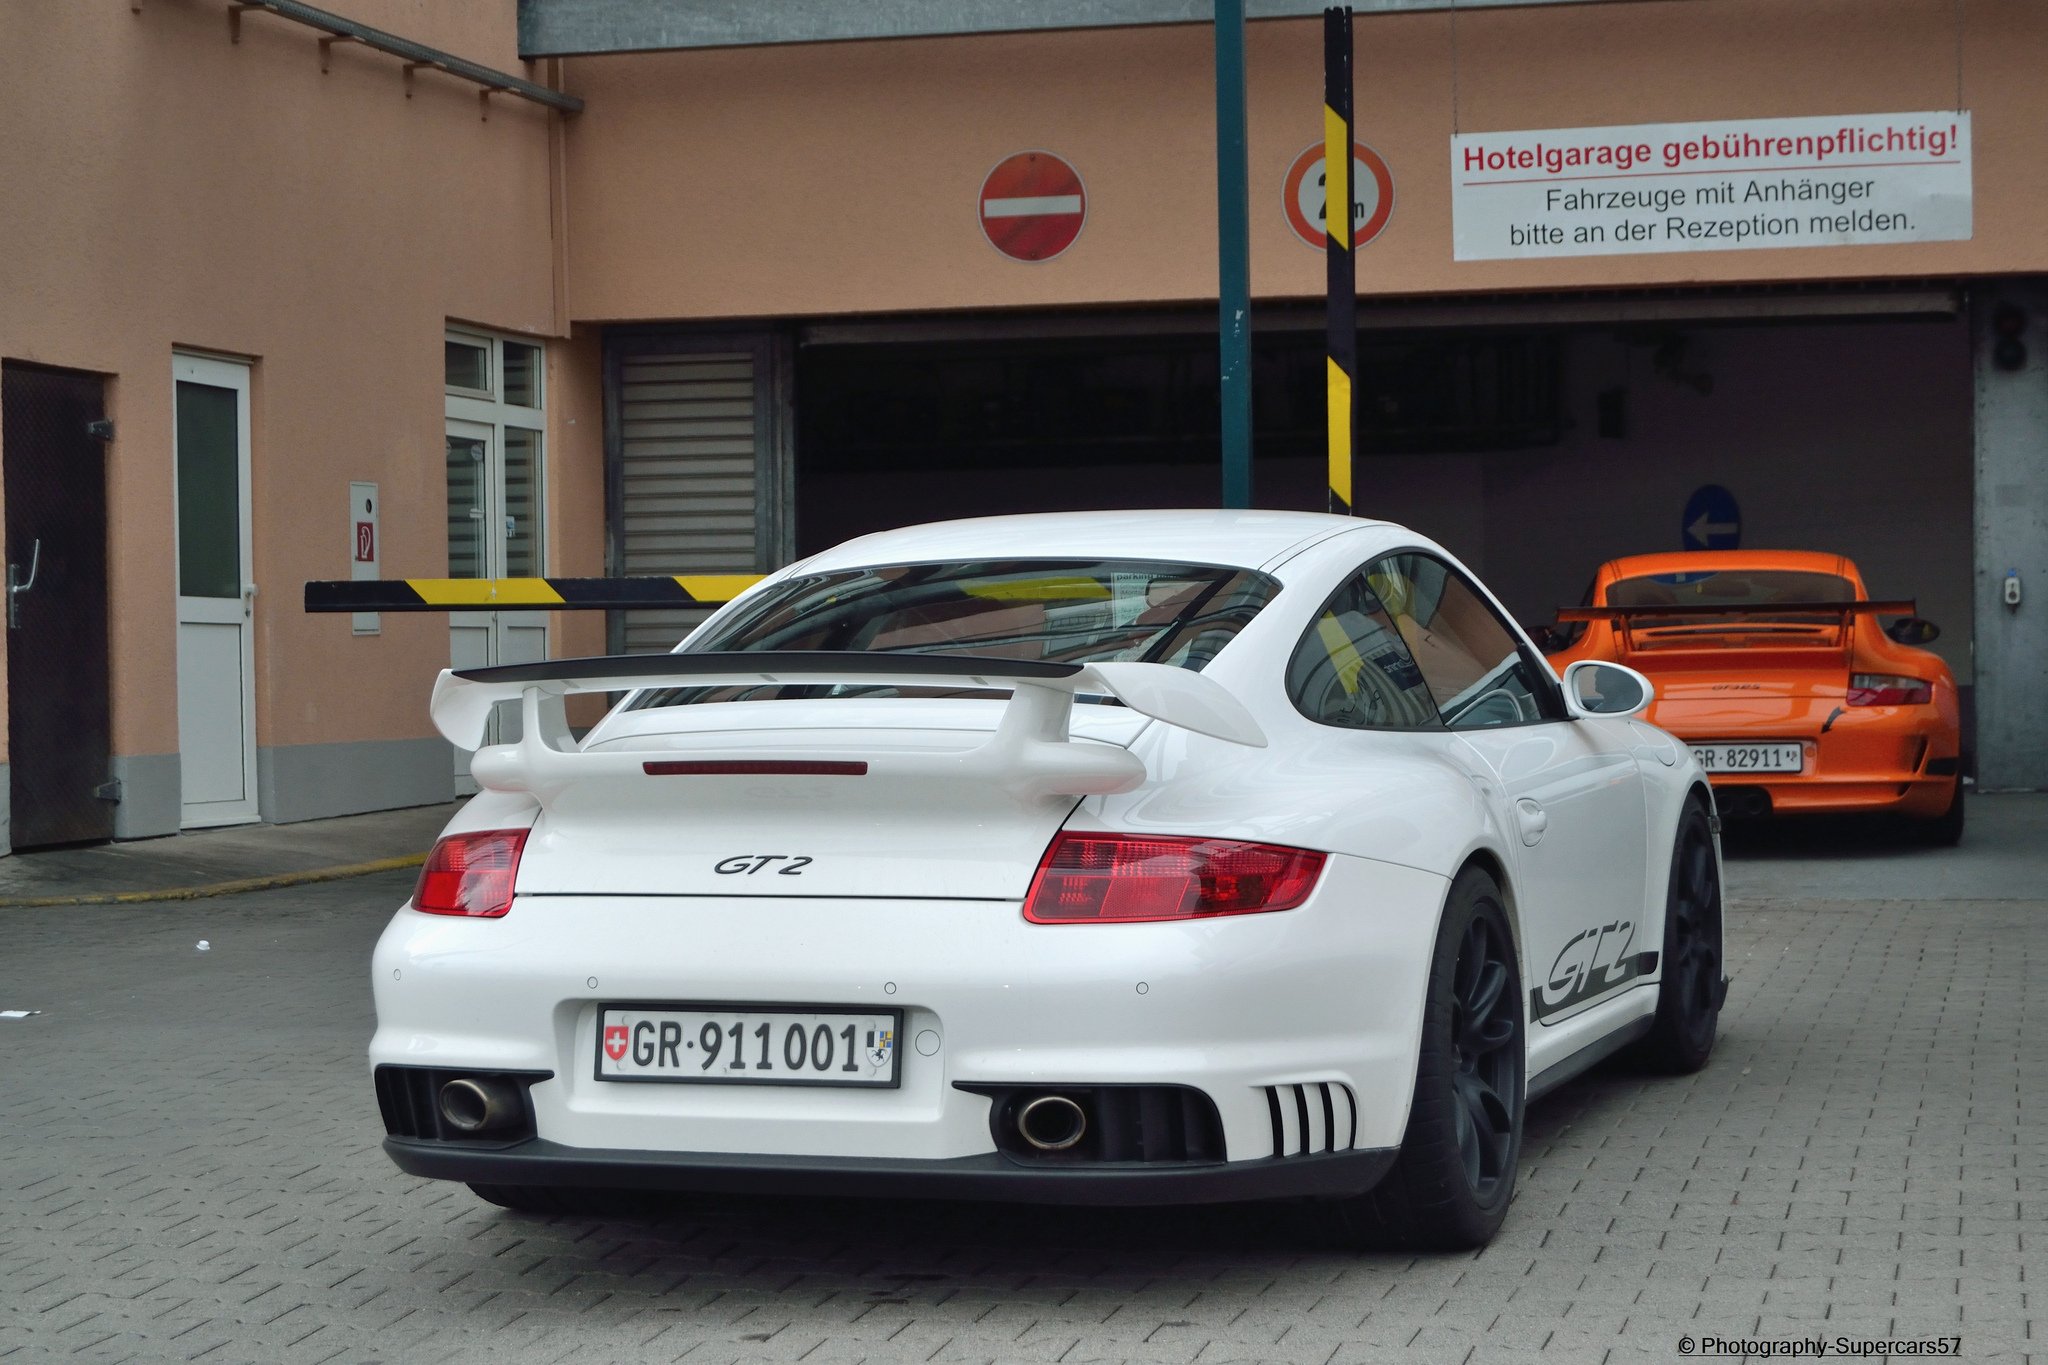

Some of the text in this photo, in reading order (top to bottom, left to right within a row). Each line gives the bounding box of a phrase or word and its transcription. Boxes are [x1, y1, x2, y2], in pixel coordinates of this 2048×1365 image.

[1463, 124, 1958, 173] Hotelgarage gebührenpflichtig!
[1546, 178, 1875, 212] Fahrzeuge mit Anhänger
[1510, 208, 1916, 246] bitte an der Rezeption melden.
